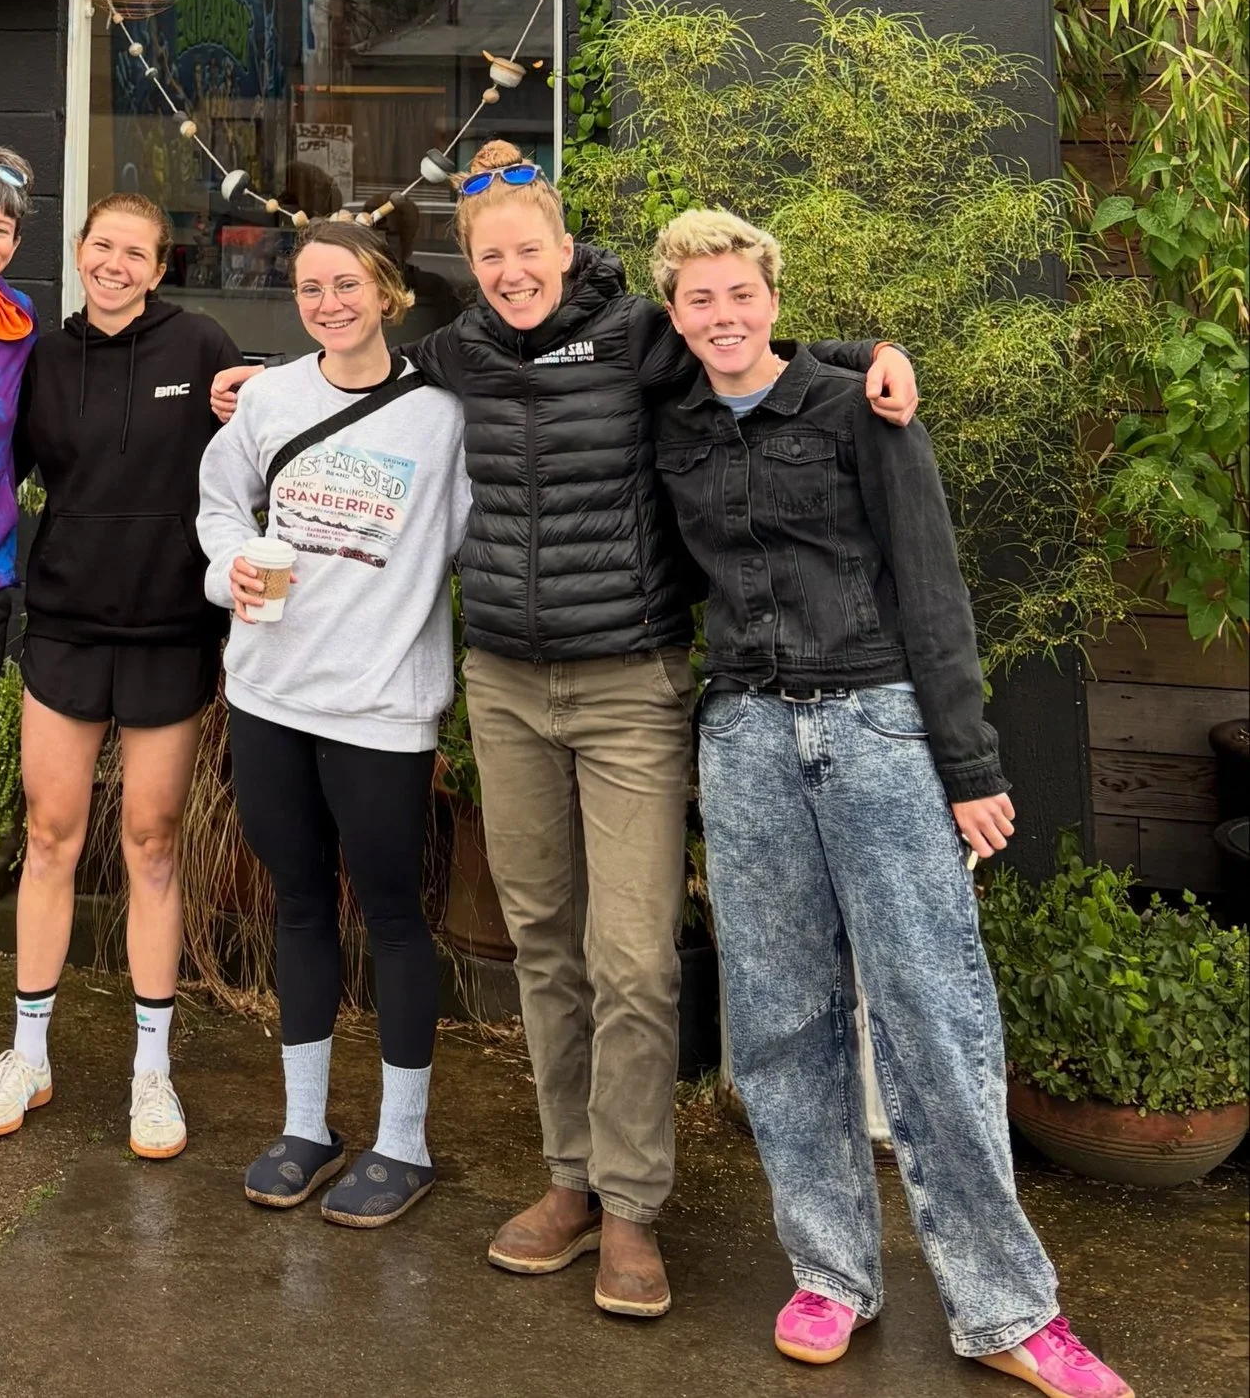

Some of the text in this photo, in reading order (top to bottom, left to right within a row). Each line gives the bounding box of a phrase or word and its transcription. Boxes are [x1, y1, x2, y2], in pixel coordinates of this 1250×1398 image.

[567, 341, 594, 356] S&M
[154, 382, 191, 398] BMC
[324, 483, 379, 500] WASHINGTON
[277, 486, 396, 520] CRANBERRIES
